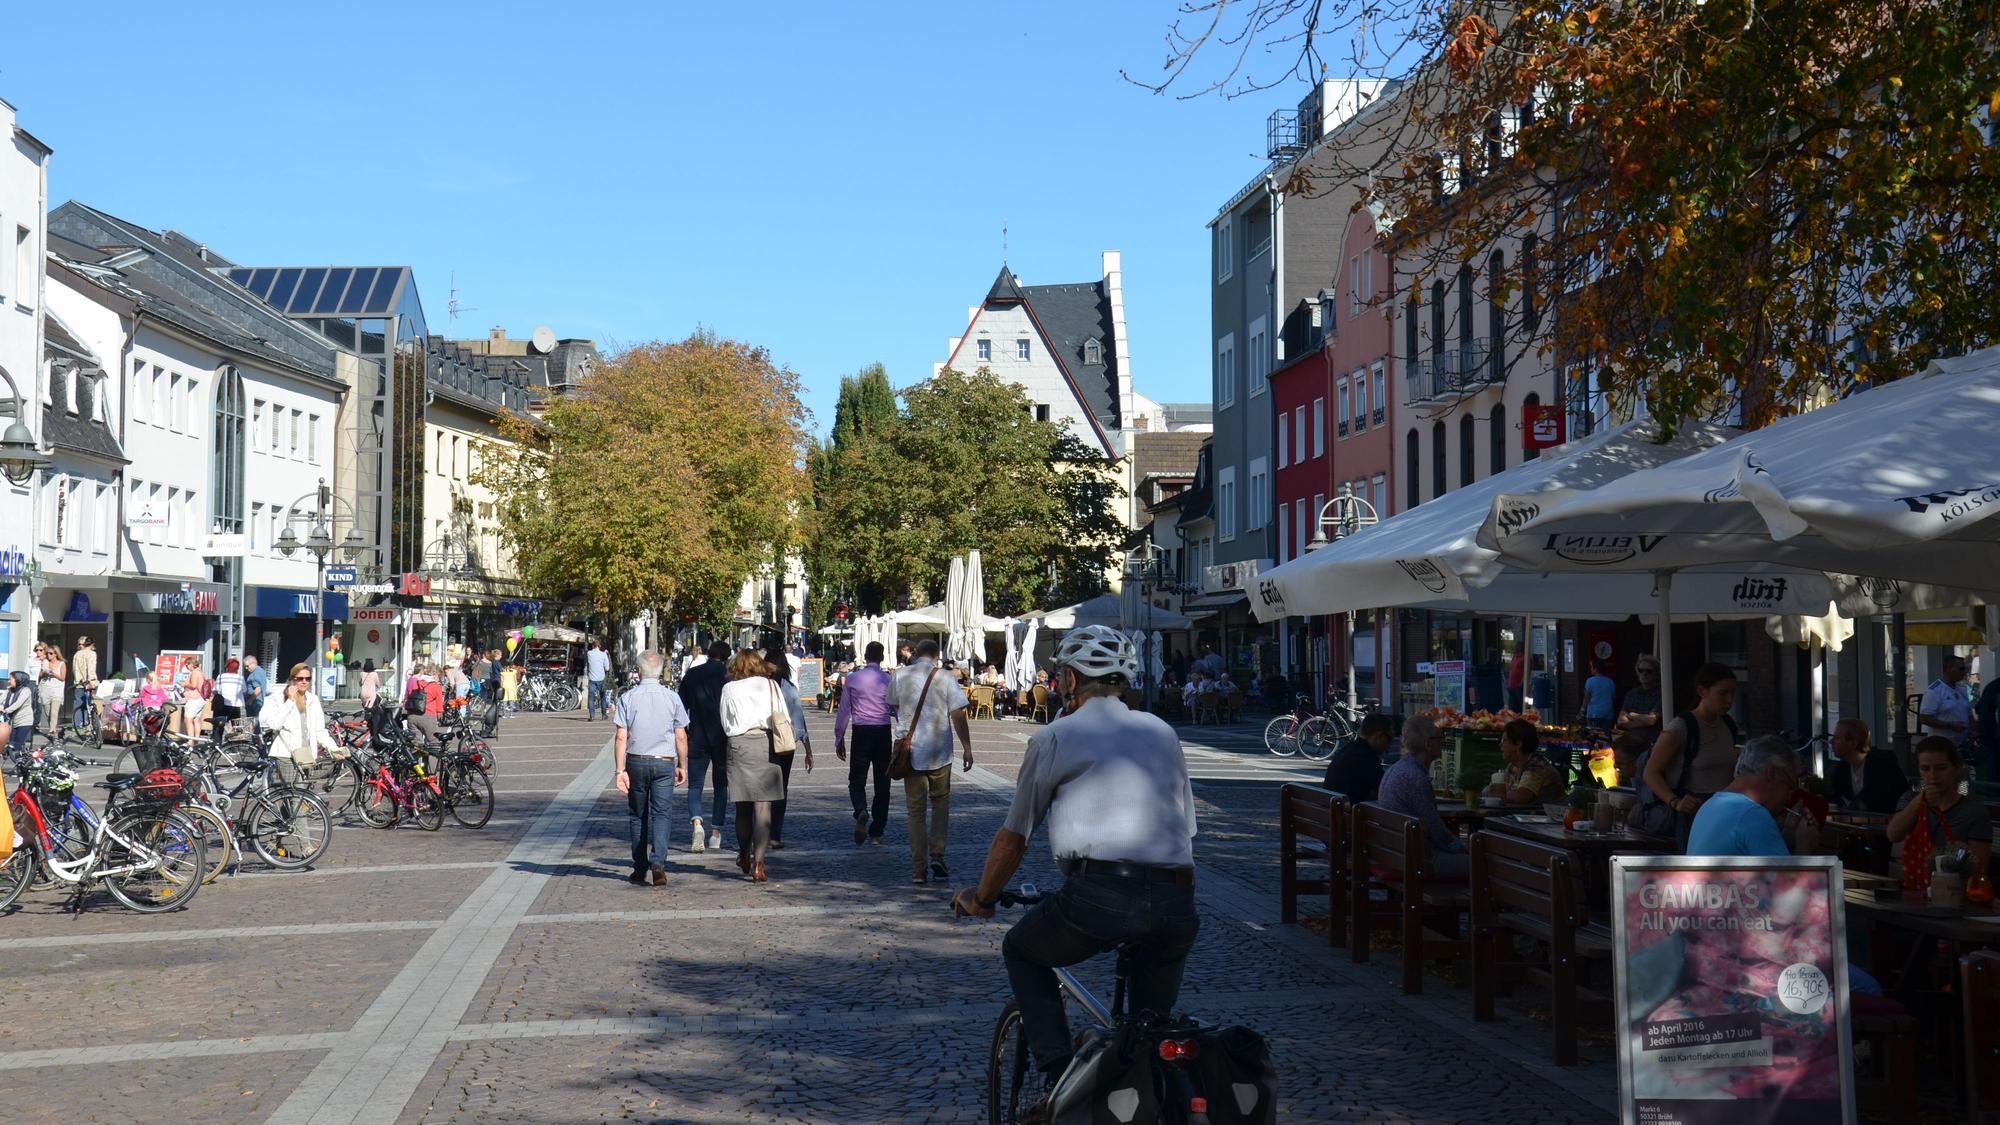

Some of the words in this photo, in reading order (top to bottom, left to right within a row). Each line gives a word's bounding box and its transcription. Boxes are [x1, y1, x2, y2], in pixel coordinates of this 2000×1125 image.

[328, 573, 353, 581] KIND
[350, 583, 395, 594] Augenoptik
[298, 593, 319, 614] KIN
[1640, 883, 1760, 909] GAMBAS
[1640, 911, 1664, 930] All
[1667, 916, 1704, 935] you
[1707, 916, 1739, 930] can
[1744, 914, 1774, 931] eat
[1648, 1026, 1660, 1036] ab
[1660, 1023, 1682, 1036] April
[1683, 1021, 1705, 1032] 2016
[1649, 1036, 1675, 1047] Jeden
[1677, 1033, 1711, 1043] Montag
[1712, 1032, 1724, 1040] ab
[1725, 1029, 1736, 1038] 17
[1737, 1028, 1753, 1038] Uhr
[1731, 1050, 1746, 1058] und
